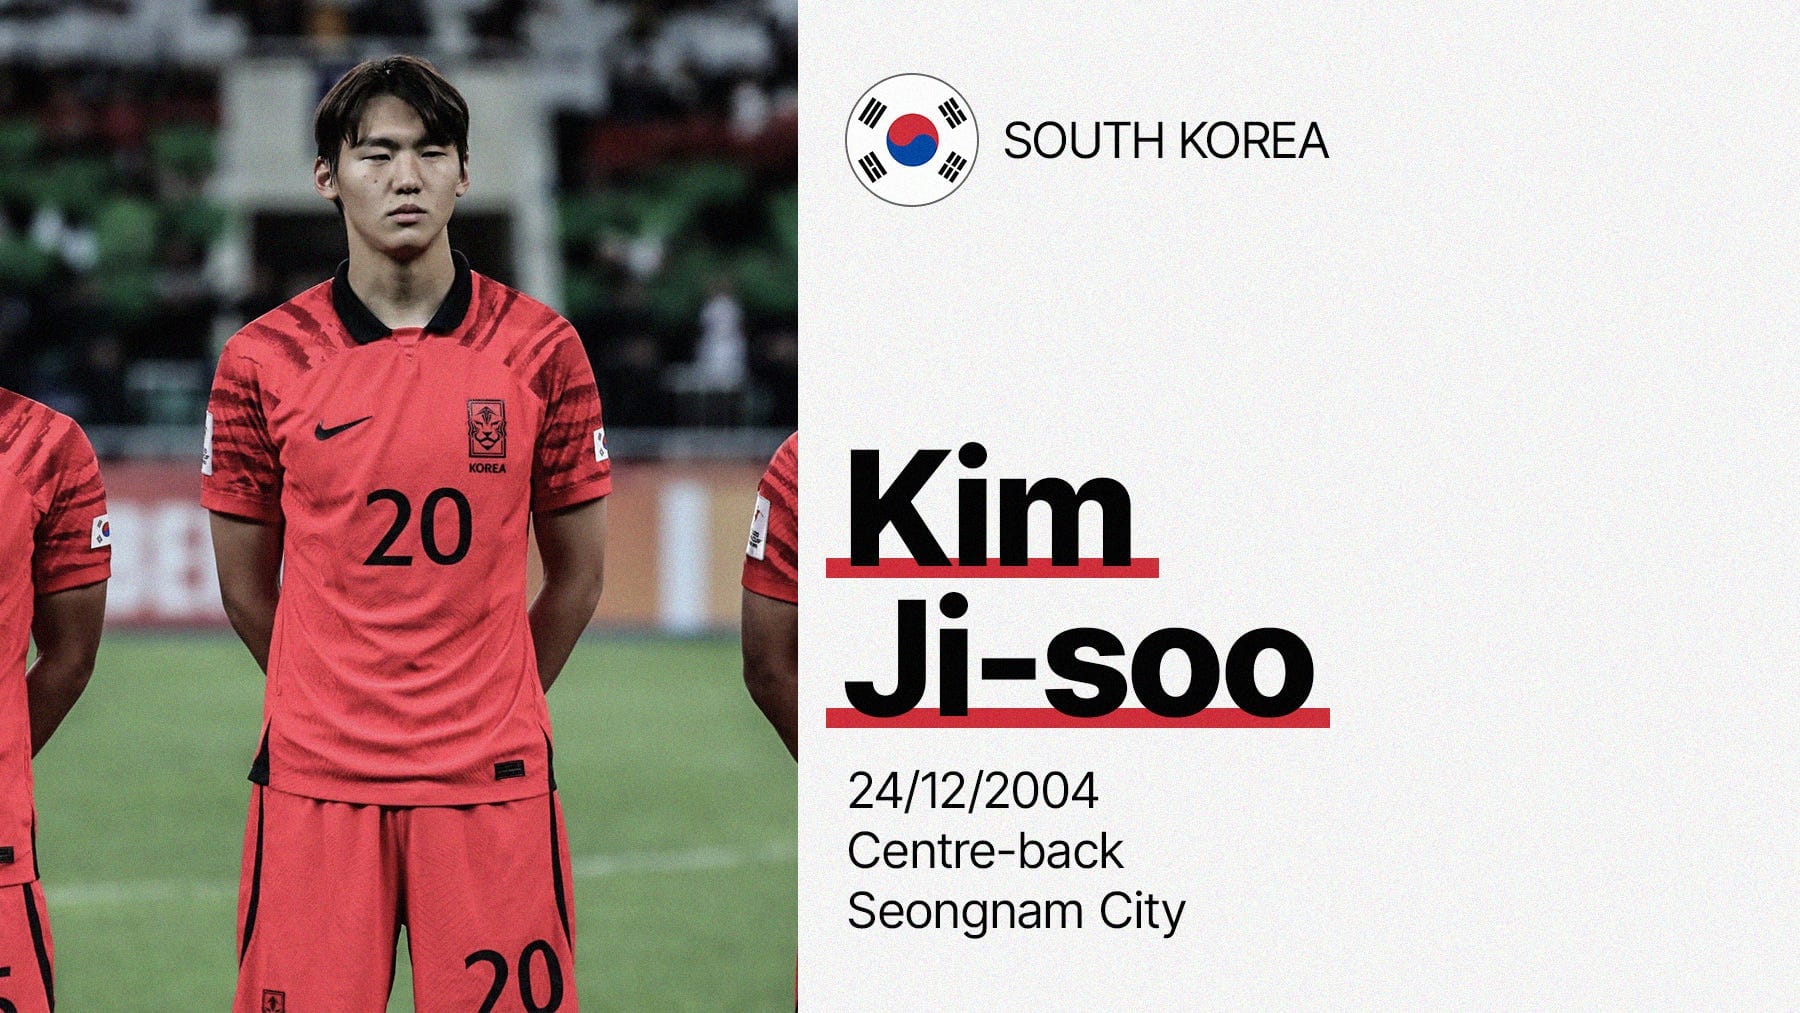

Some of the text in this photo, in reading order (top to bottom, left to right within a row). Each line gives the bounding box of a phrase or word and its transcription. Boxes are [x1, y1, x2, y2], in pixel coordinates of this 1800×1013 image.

[468, 462, 507, 474] KOREA
[363, 487, 473, 567] 20
[464, 939, 564, 1013] 20
